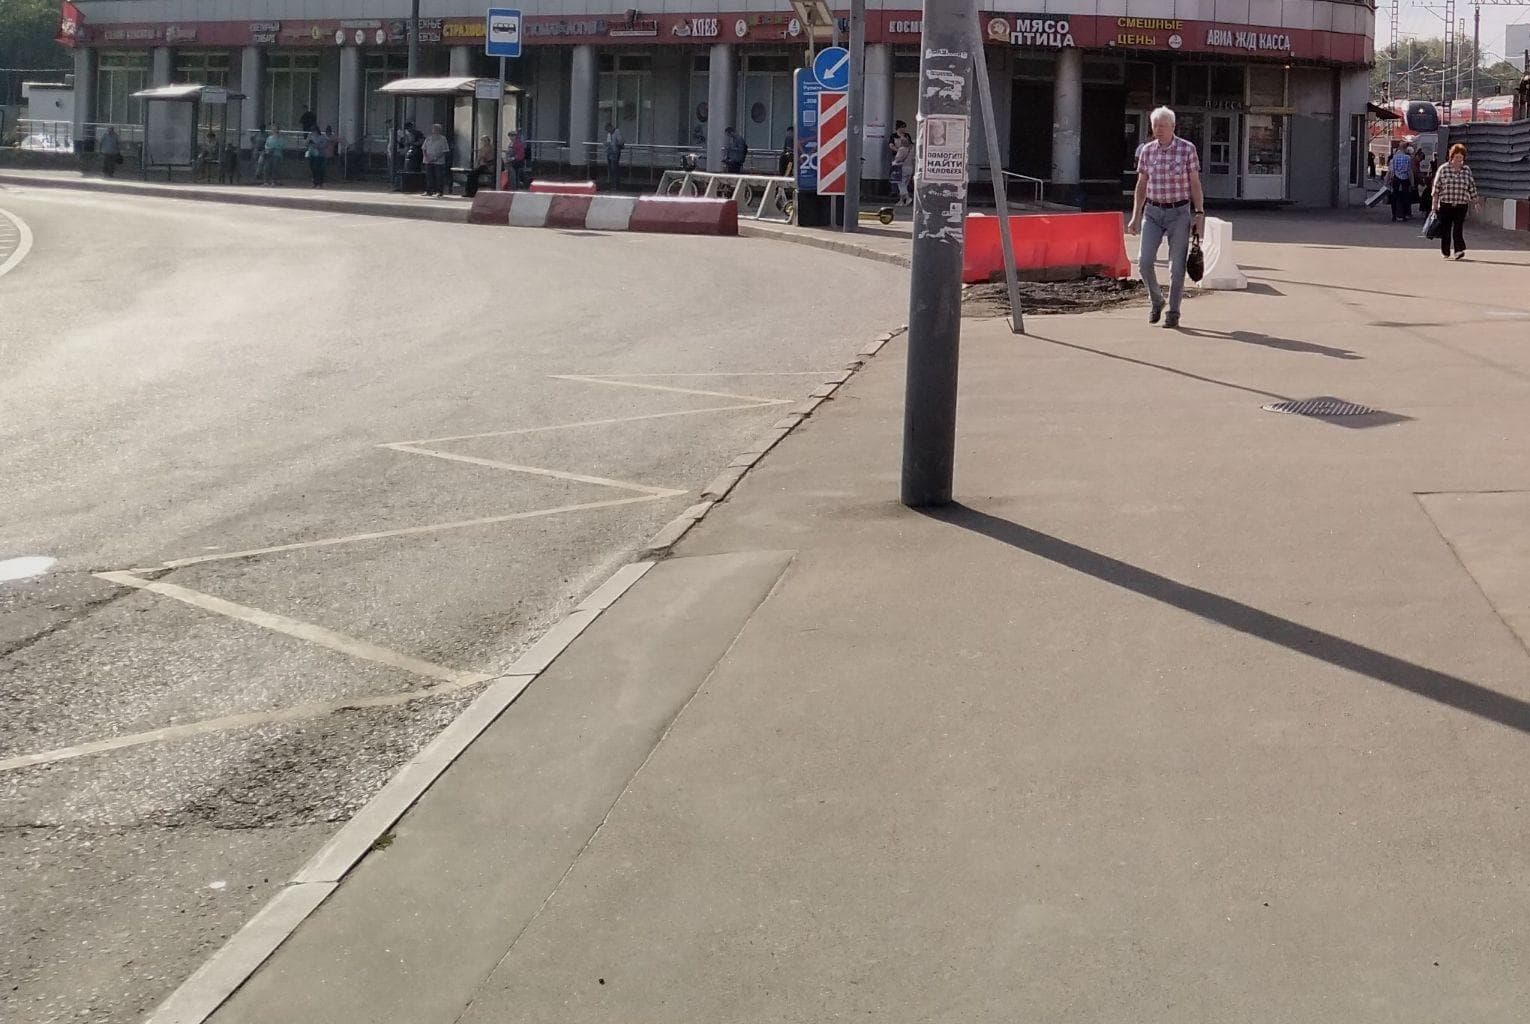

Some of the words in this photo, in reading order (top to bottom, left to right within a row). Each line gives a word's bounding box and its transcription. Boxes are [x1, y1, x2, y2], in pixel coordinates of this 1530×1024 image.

[1016, 19, 1069, 34] МЯСО
[1117, 17, 1184, 30] СМЕШНЫЕ
[1010, 31, 1075, 47] ПТИЦА
[1117, 34, 1156, 46] ЦЕНЫ
[1207, 29, 1232, 48] АВИА
[1234, 32, 1257, 51] Ж/Д
[1259, 33, 1291, 52] КАССА
[927, 159, 962, 167] НАЙТИ
